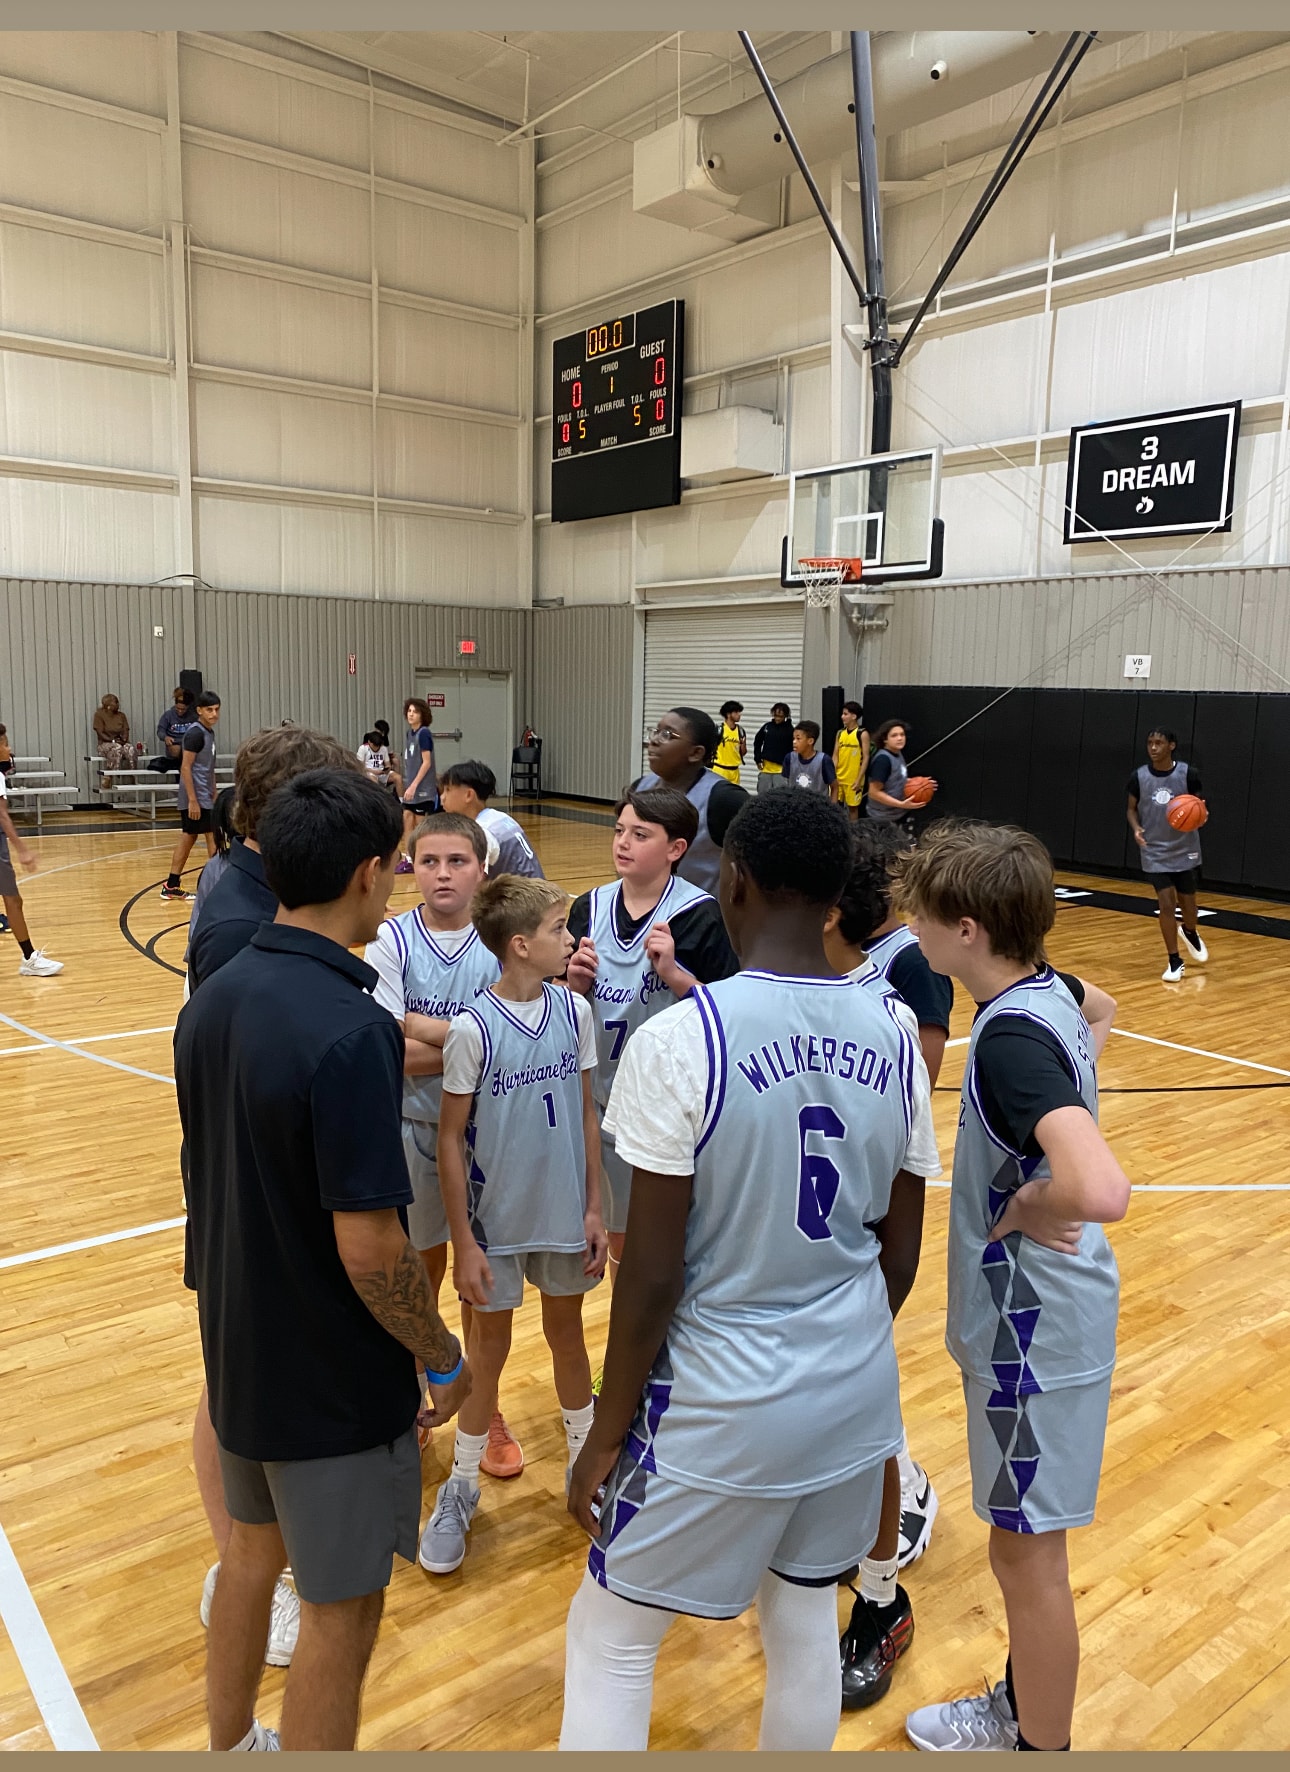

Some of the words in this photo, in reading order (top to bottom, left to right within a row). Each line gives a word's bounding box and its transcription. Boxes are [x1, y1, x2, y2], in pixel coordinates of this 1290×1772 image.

[588, 320, 623, 356] 00.0
[640, 339, 666, 359] GUEST
[561, 365, 581, 383] HOME
[601, 361, 619, 375] PERIOD
[655, 357, 665, 385] 0
[572, 381, 582, 408] 0
[649, 387, 667, 400] FOULS
[594, 403, 613, 415] PLAYER
[613, 398, 626, 409] FOUL
[633, 405, 641, 426] 5
[656, 399, 664, 420] 0
[557, 412, 572, 424] FOULS
[562, 423, 570, 443] 0
[578, 419, 586, 439] 5
[649, 423, 666, 437] SCORE
[600, 435, 618, 448] MATCH
[1140, 435, 1159, 462] 3
[557, 446, 572, 458] SCORE
[1102, 459, 1196, 494] DREAM
[1132, 658, 1143, 666] VB
[604, 1019, 628, 1061] 7
[736, 1033, 894, 1097] WILKERSON
[491, 1064, 560, 1097] Hurricane
[542, 1091, 557, 1129] 1
[795, 1102, 849, 1244] 6
